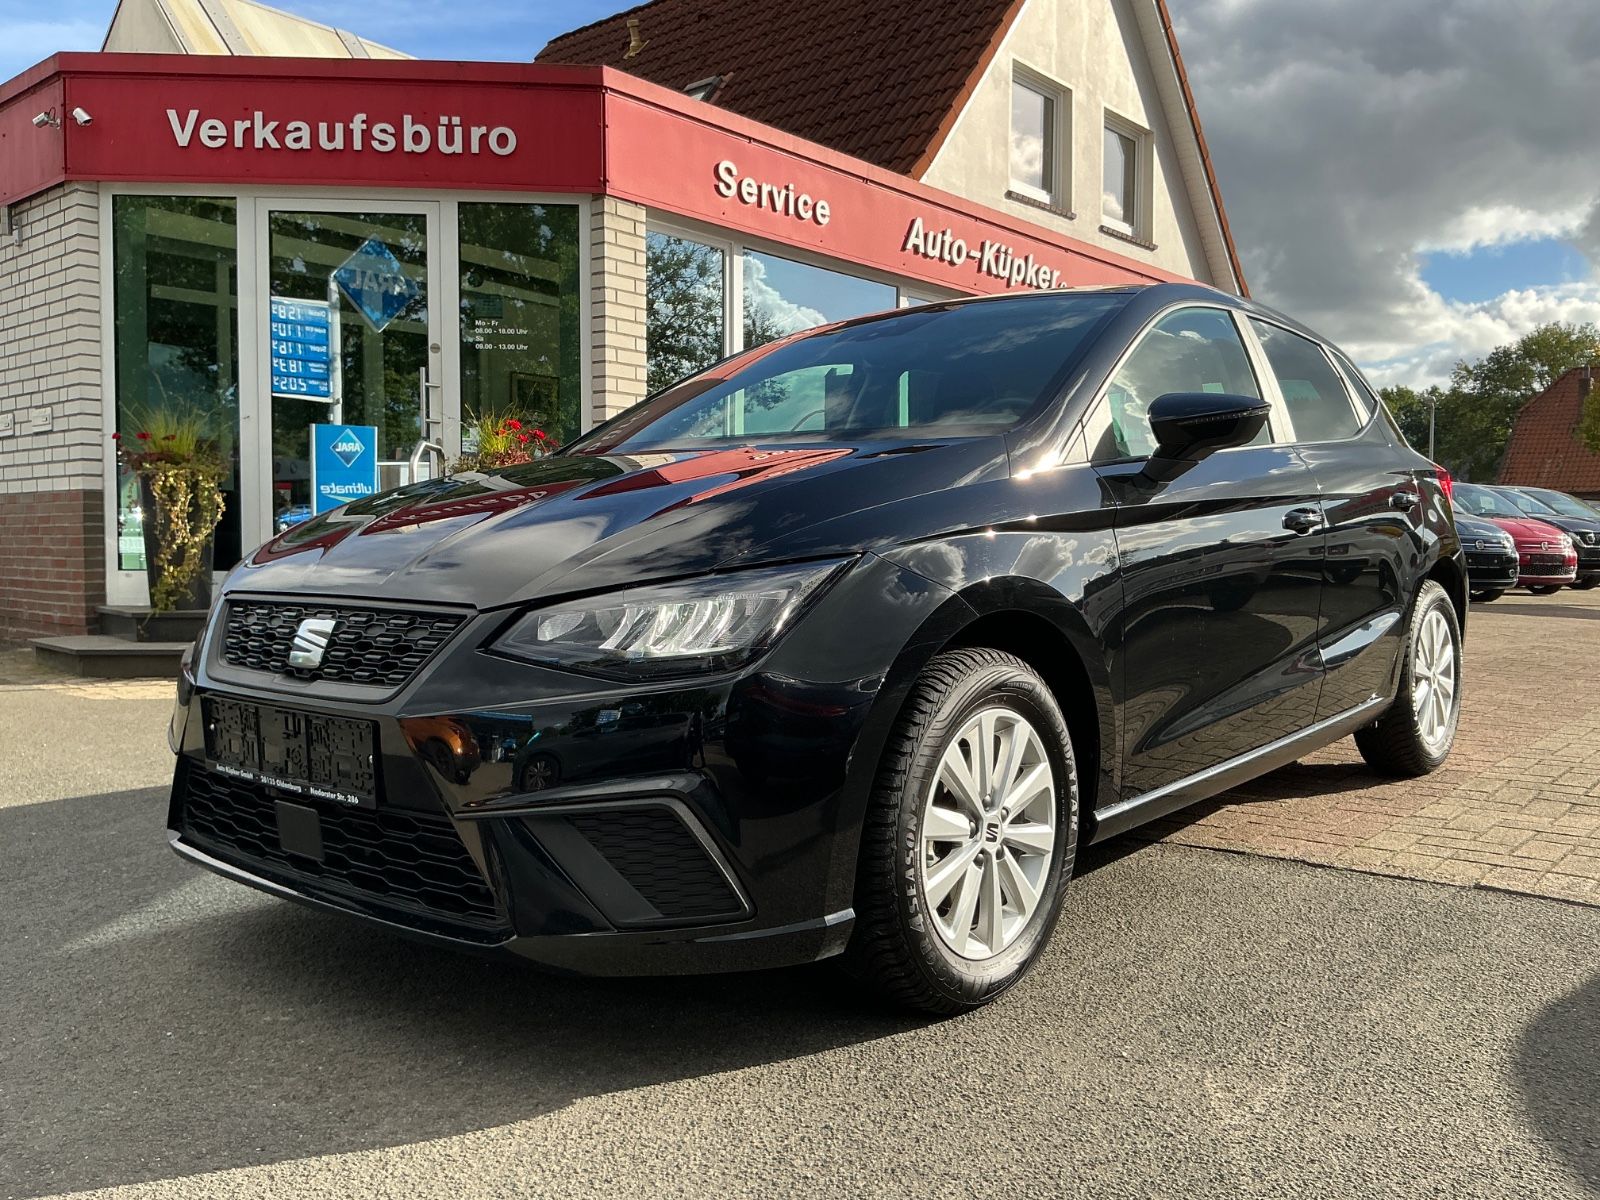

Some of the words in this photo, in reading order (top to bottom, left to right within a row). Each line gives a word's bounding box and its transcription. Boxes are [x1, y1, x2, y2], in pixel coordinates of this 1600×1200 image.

[166, 109, 518, 156] Verkaufsbüro
[716, 160, 831, 225] Service
[904, 216, 1061, 289] Auto-Küpker
